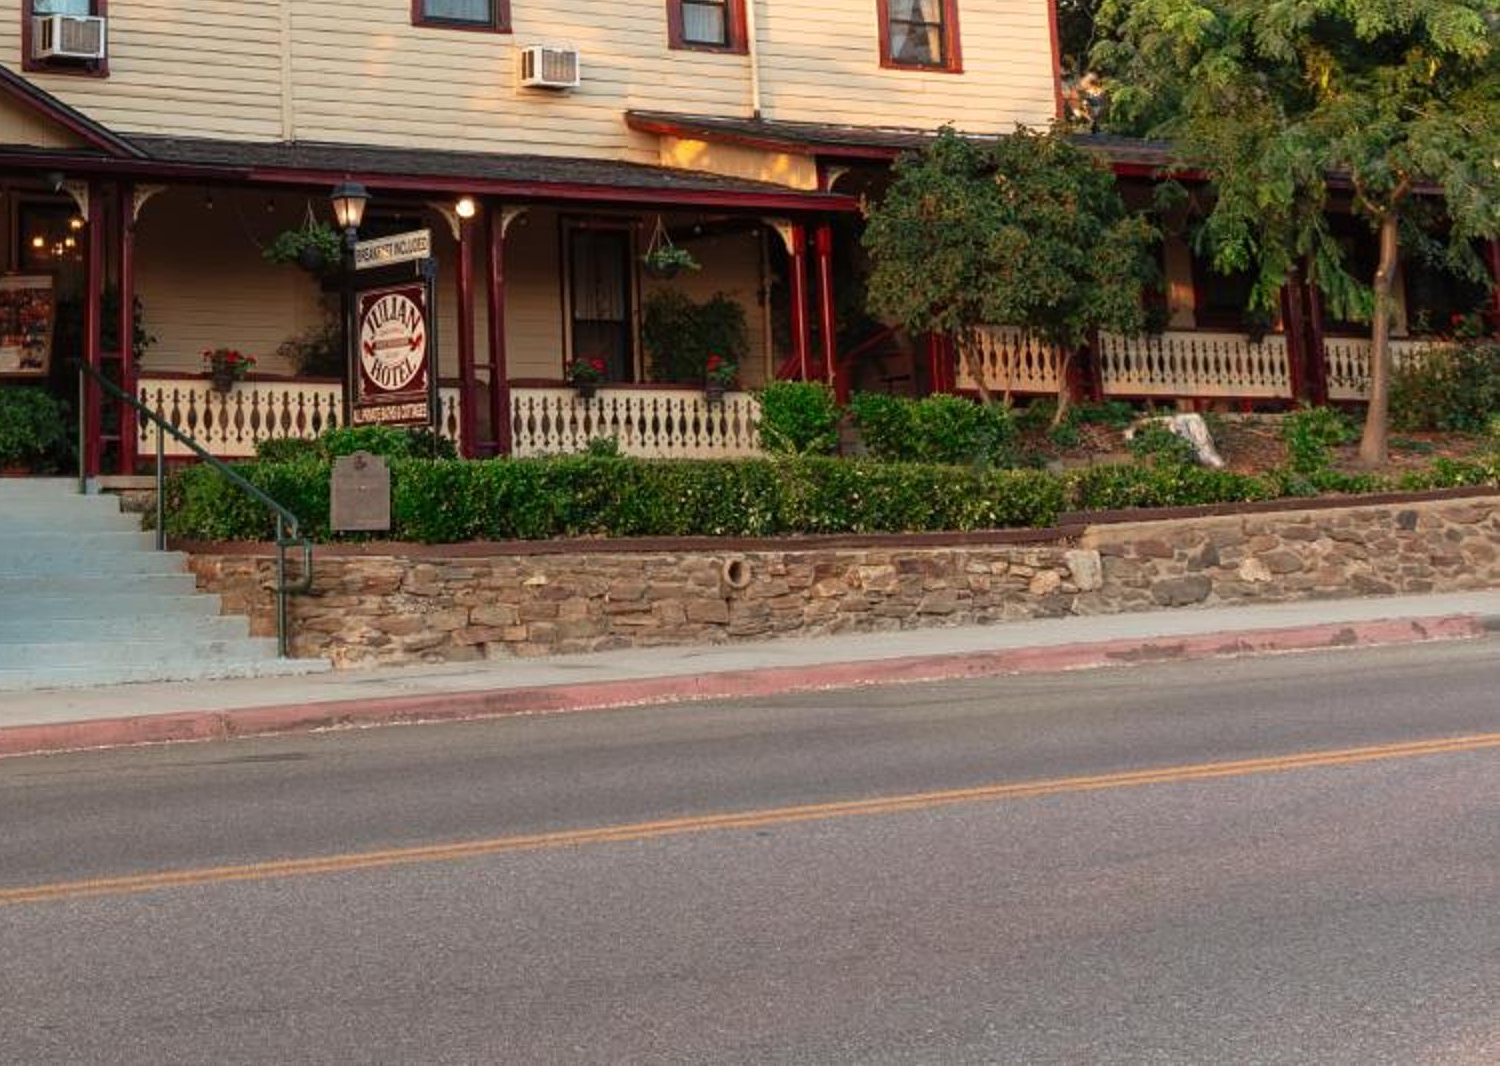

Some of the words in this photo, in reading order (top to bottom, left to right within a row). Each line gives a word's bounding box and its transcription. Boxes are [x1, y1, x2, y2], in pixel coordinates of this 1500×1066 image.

[393, 236, 427, 255] INCLUDED
[366, 296, 421, 340] JULIAN
[370, 357, 417, 387] HOTEL
